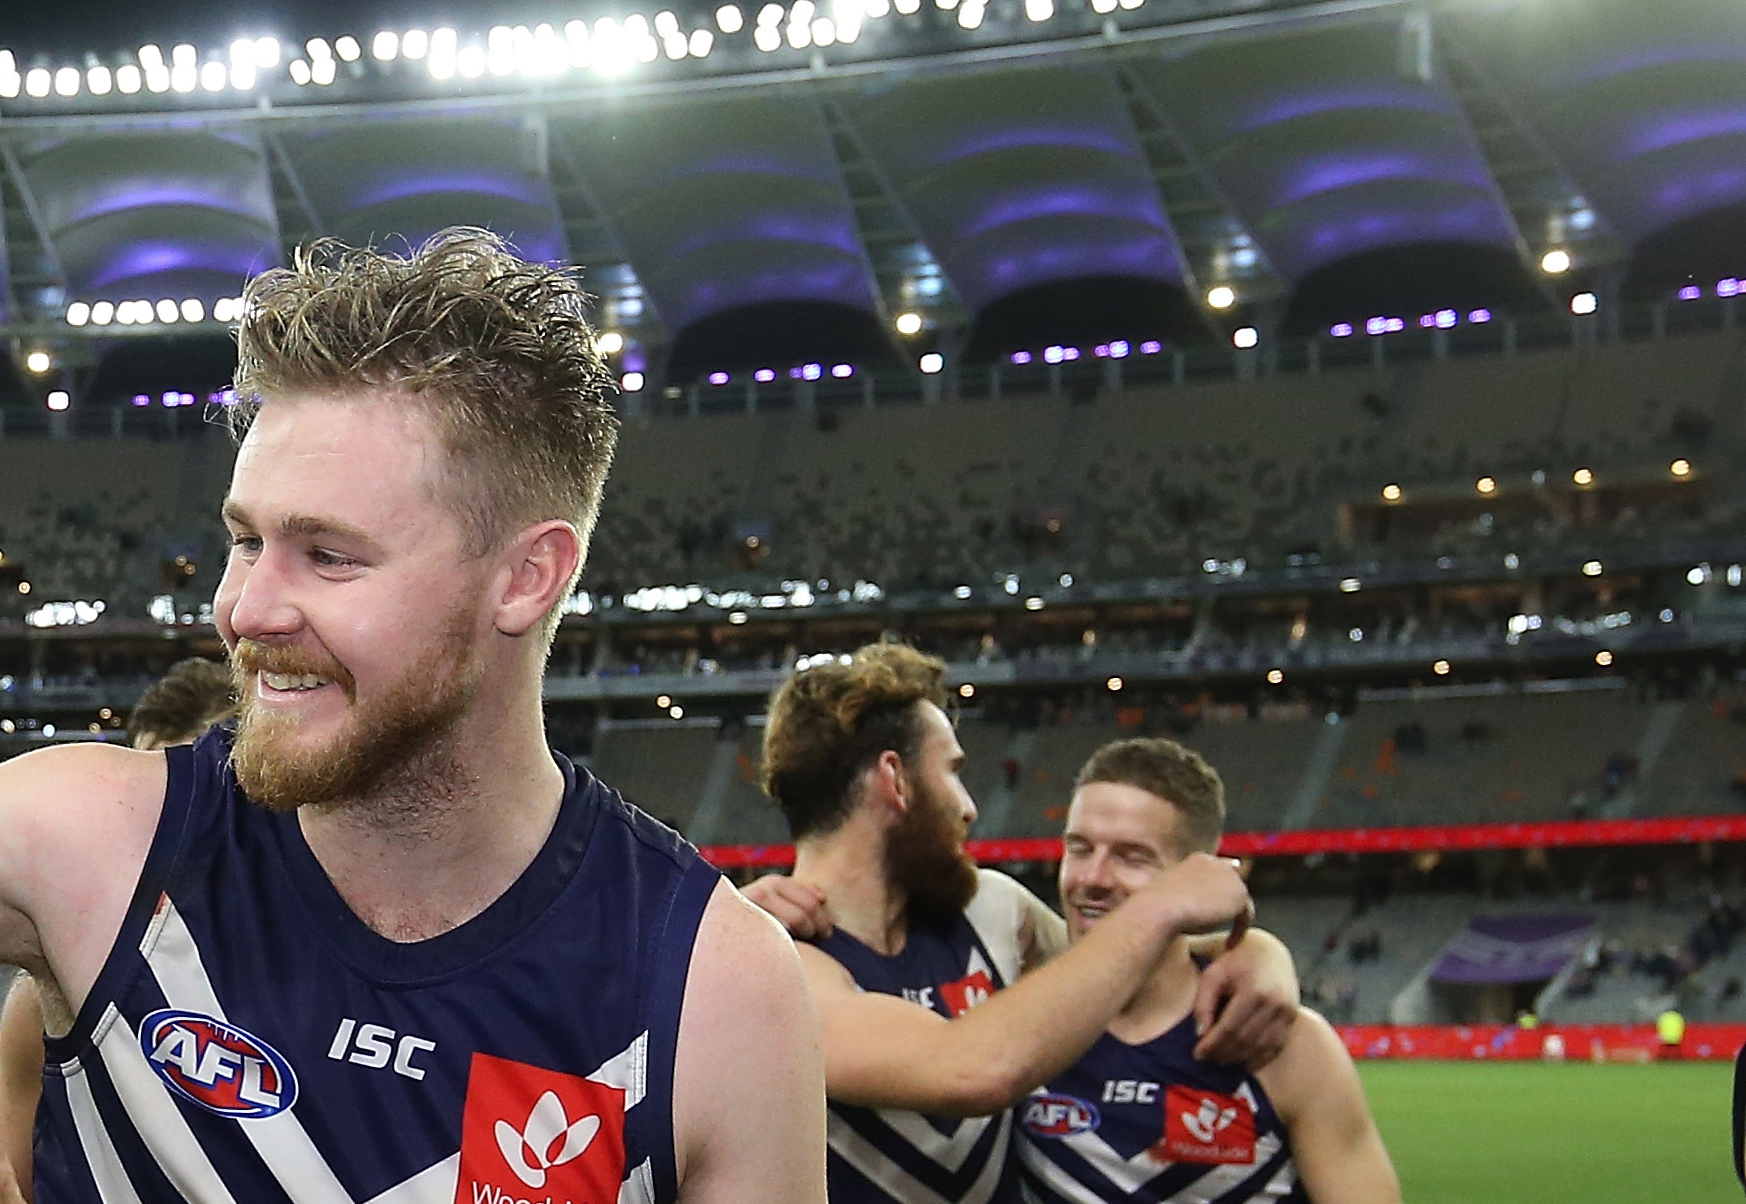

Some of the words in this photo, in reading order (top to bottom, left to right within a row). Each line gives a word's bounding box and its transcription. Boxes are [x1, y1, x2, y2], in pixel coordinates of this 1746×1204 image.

[151, 1024, 281, 1108] AFL
[328, 1018, 436, 1081] ISC
[1103, 1080, 1161, 1103] ISC
[1024, 1103, 1092, 1128] AFL
